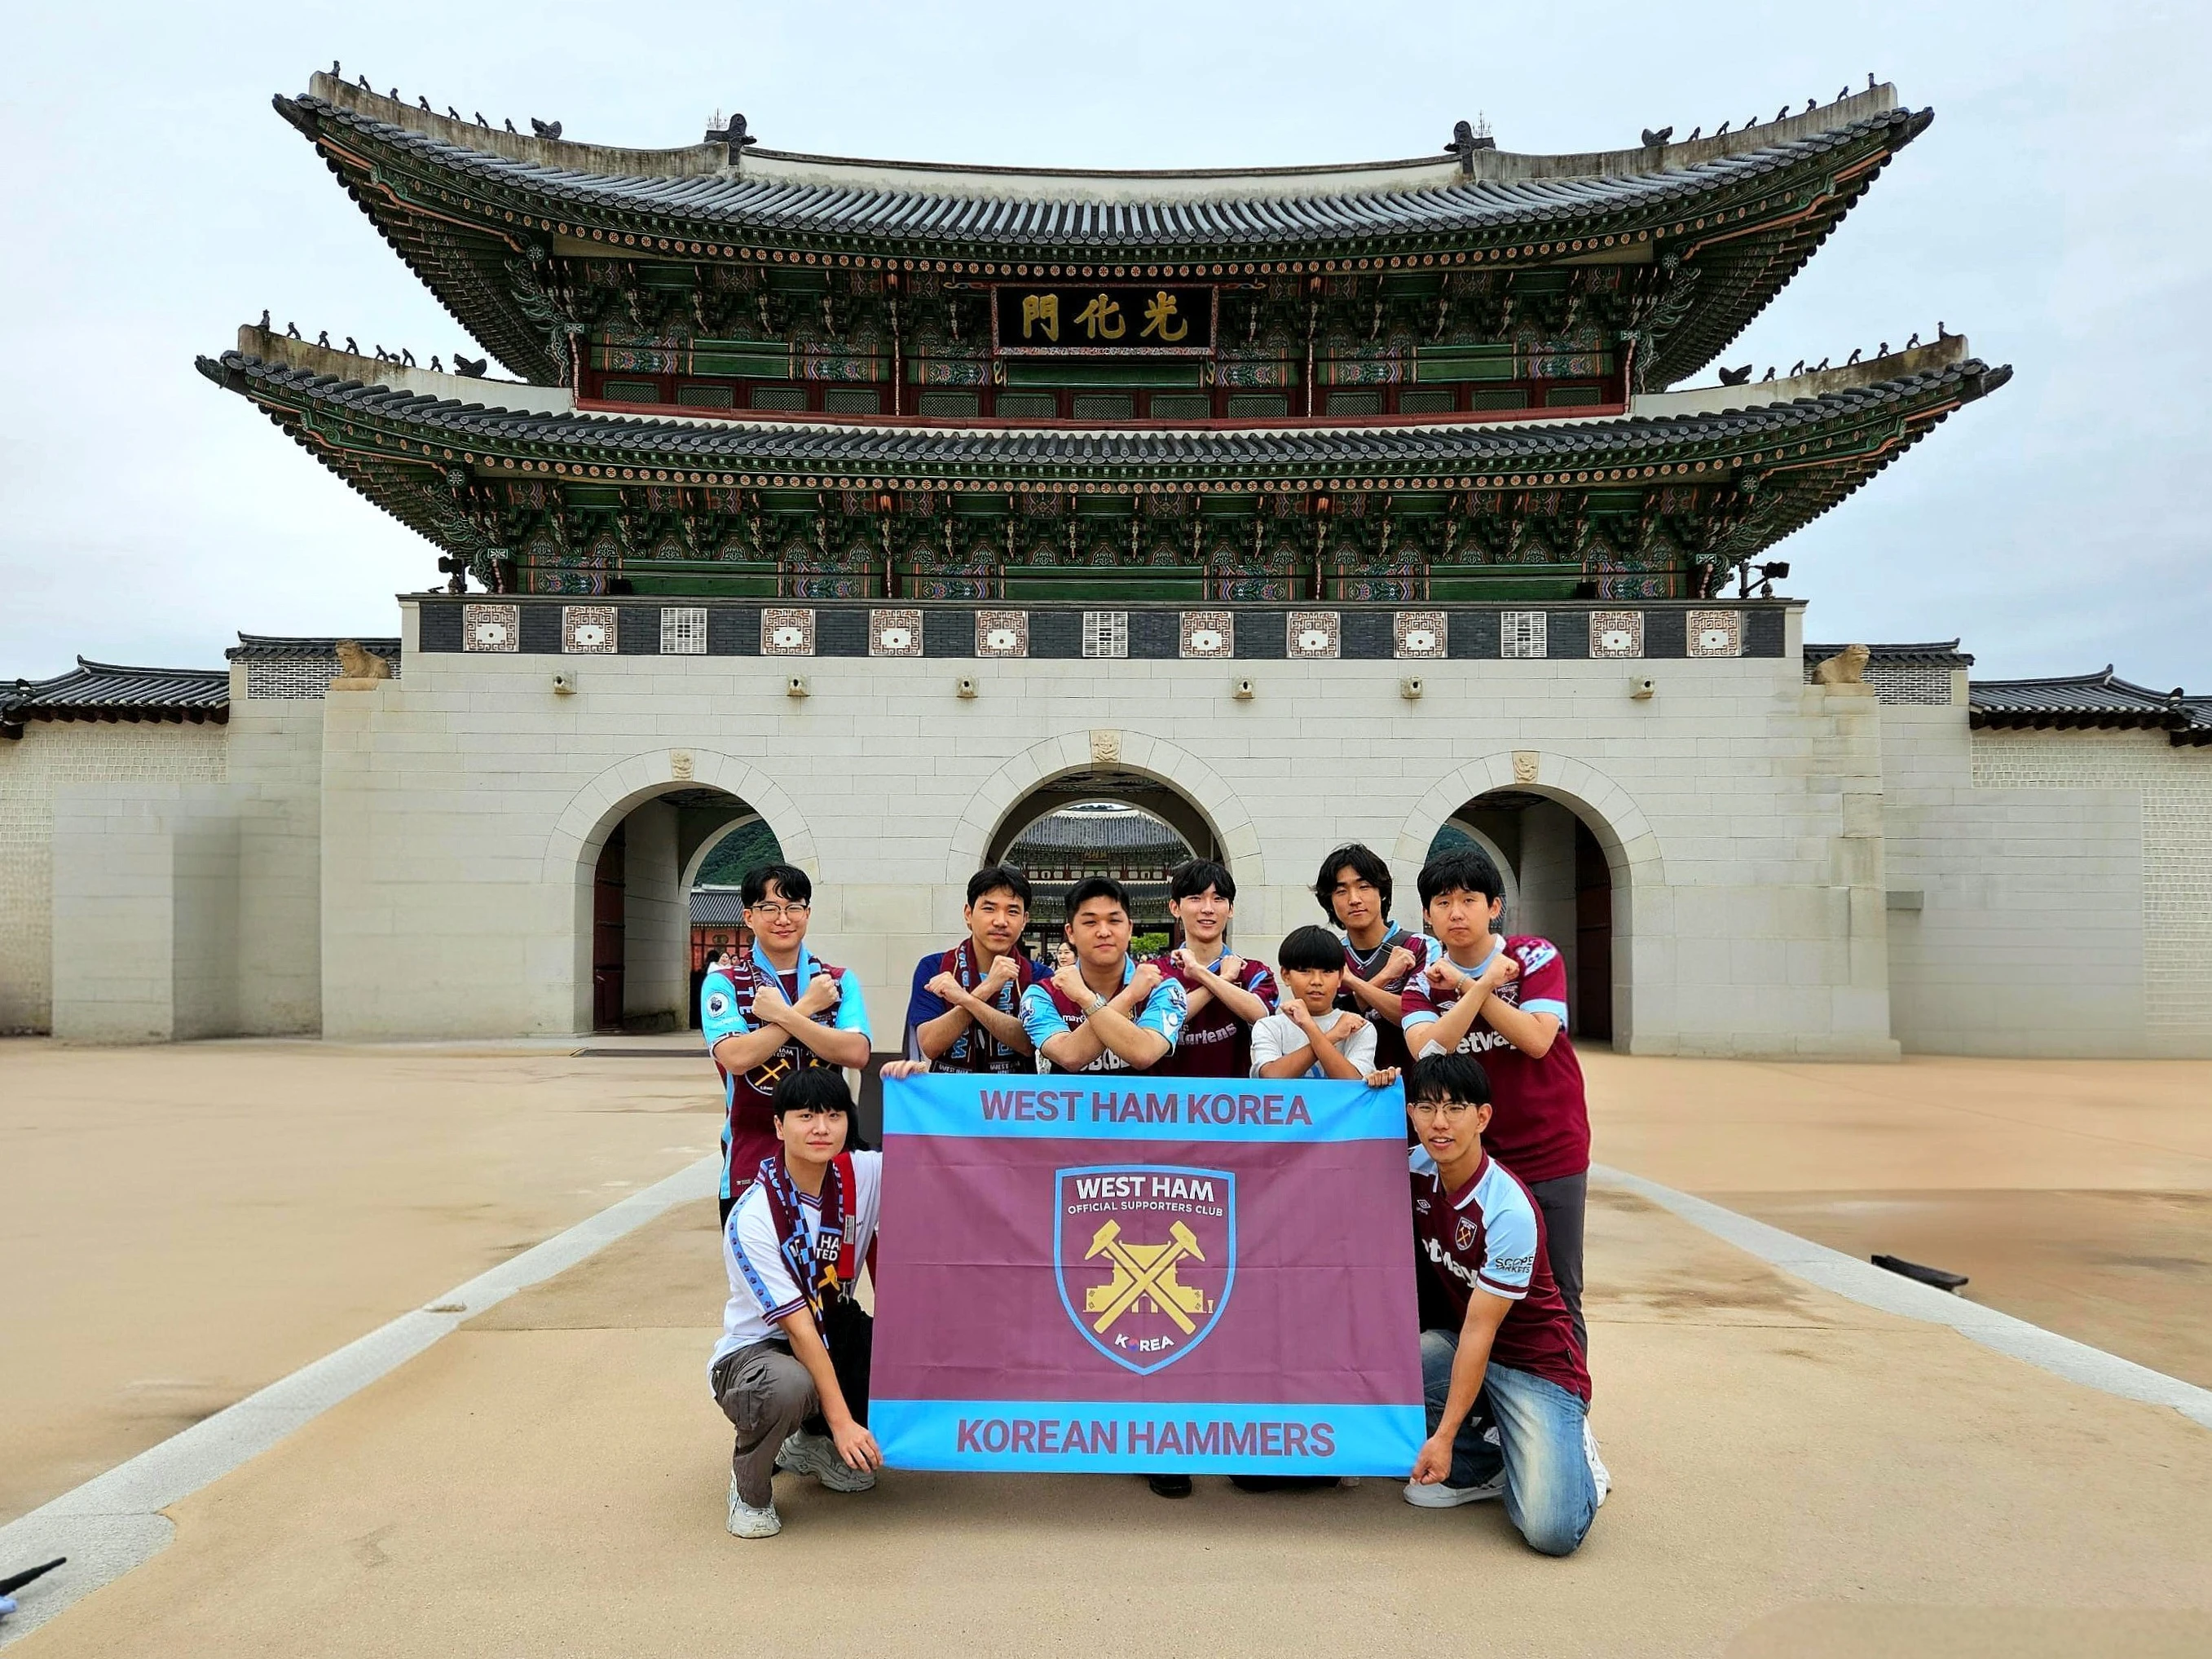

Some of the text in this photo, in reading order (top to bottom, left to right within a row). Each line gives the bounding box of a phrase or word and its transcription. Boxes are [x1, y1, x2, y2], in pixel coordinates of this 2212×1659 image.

[980, 1090, 1312, 1125] WEST HAM KOREA
[1076, 1176, 1214, 1202] WEST HAM
[1068, 1201, 1223, 1217] OFFICIAL SUPPORTERS CLUB
[821, 1234, 841, 1251] HA
[816, 1247, 838, 1261] TED
[1496, 1256, 1533, 1267] SCOPE
[956, 1419, 1336, 1458] KOREAN HAMMERS
